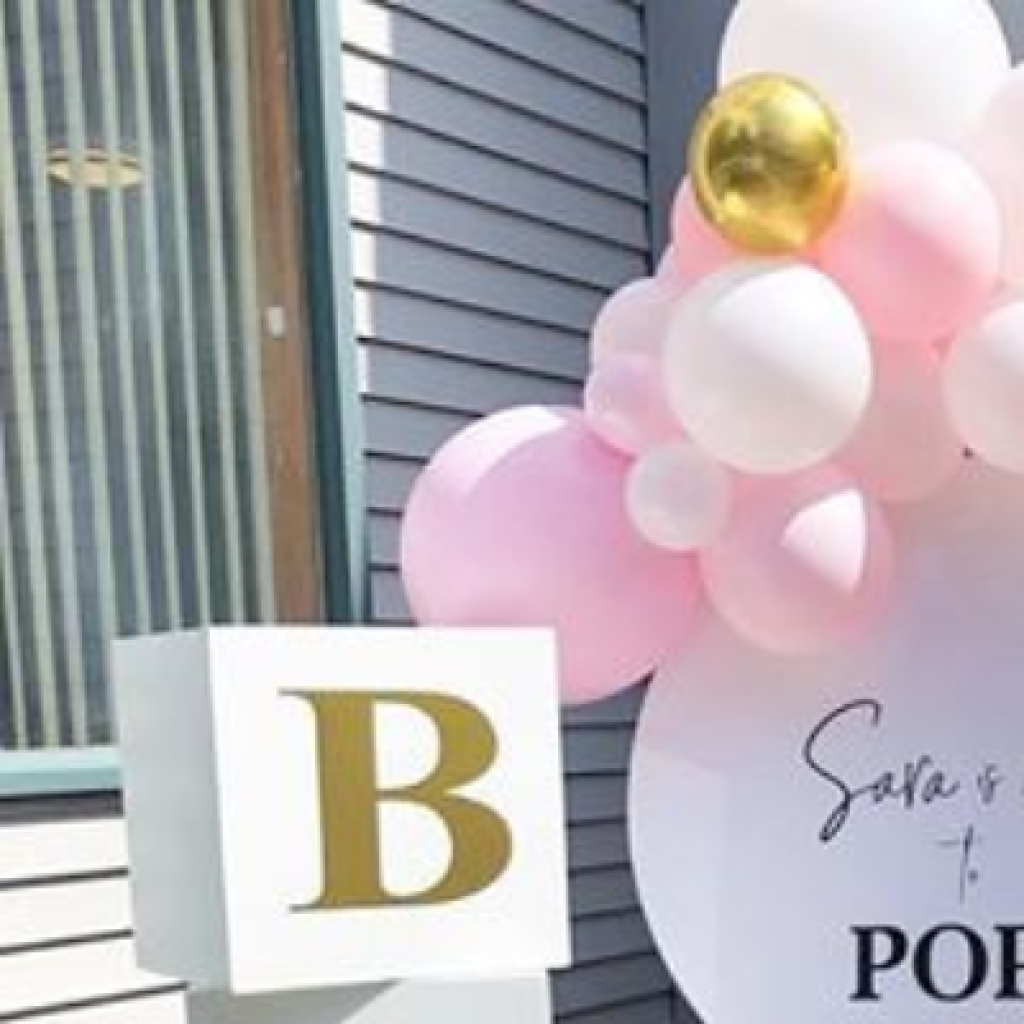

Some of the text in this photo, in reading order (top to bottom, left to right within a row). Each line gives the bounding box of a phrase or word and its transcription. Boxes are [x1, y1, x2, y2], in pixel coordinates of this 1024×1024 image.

[803, 698, 960, 842] Sara
[977, 762, 1006, 807] is
[937, 824, 981, 904] to
